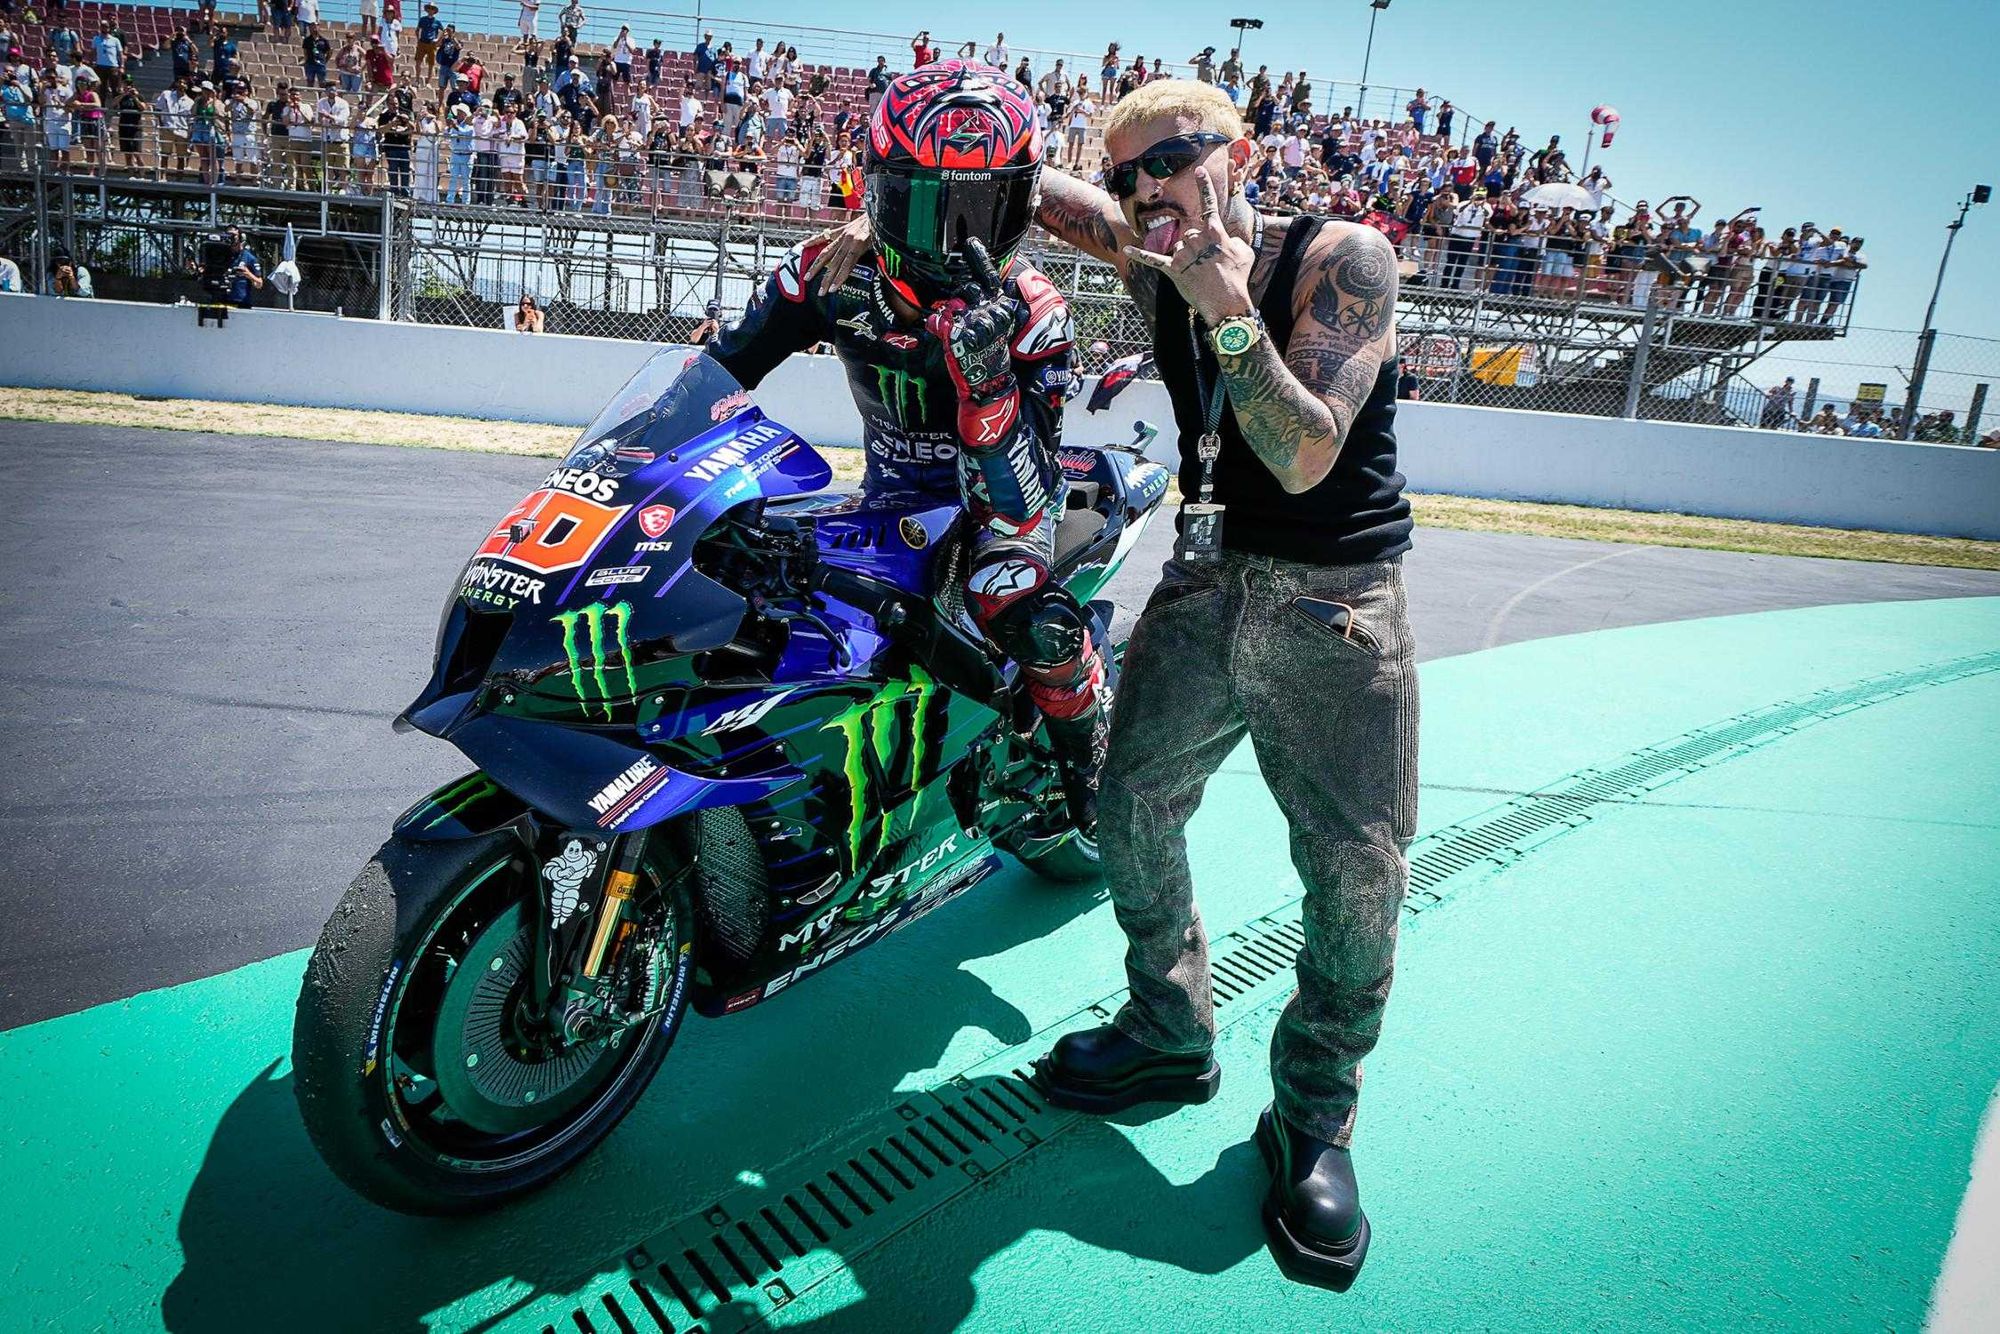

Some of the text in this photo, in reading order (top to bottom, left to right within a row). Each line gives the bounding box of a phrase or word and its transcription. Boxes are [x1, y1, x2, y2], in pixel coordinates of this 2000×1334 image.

[951, 170, 991, 181] fantom
[873, 272, 895, 325] YAMAHA
[684, 423, 782, 482] YAMAHA
[881, 433, 957, 461] ENEO
[539, 467, 620, 502] ENEOS
[634, 541, 673, 552] msi
[460, 585, 520, 610] ENERGY
[462, 561, 546, 605] MONSTER
[587, 754, 657, 815] YAMALUBE
[778, 833, 958, 952] MOSTER
[763, 907, 901, 999] ENEOS
[370, 966, 397, 1048] MICHELIN
[663, 965, 687, 1030] MICHELIN
